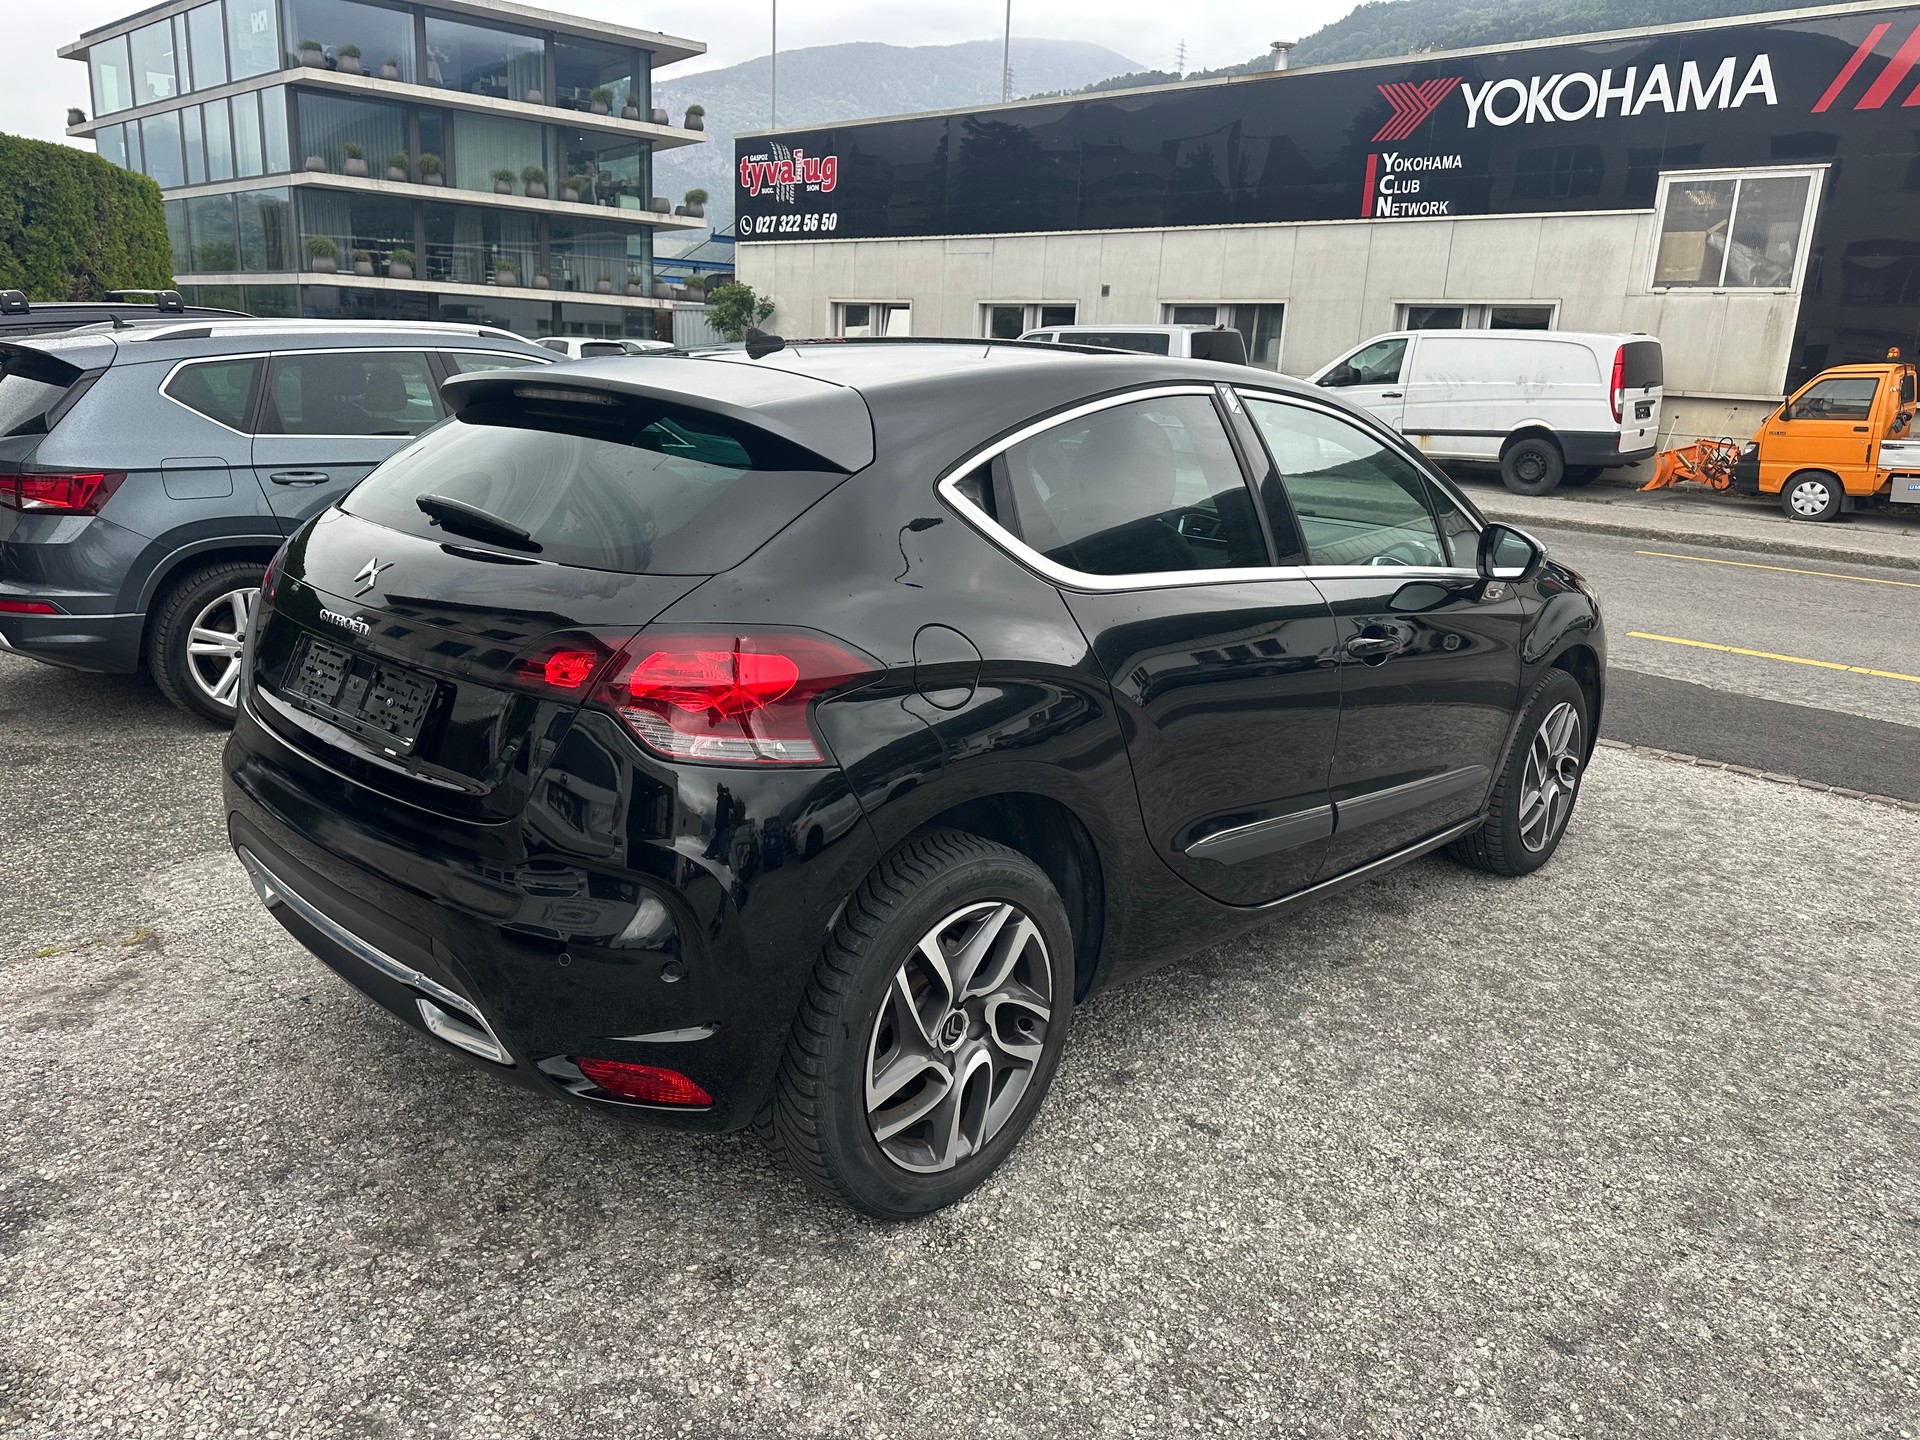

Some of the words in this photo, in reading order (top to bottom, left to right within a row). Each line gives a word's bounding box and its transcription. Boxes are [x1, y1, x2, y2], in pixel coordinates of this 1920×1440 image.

[1460, 53, 1779, 129] YOKOHAMA
[749, 154, 769, 162] GASPOZ
[1381, 152, 1463, 174] YOKOHAMA
[740, 148, 838, 197] tyvalug
[806, 184, 820, 192] SION
[1379, 174, 1421, 195] CLUB
[1376, 195, 1449, 217] NETWORK
[755, 215, 777, 233] 027
[779, 214, 801, 232] 322
[803, 213, 819, 232] 56
[820, 212, 838, 231] 50
[320, 609, 371, 636] CITROËN
